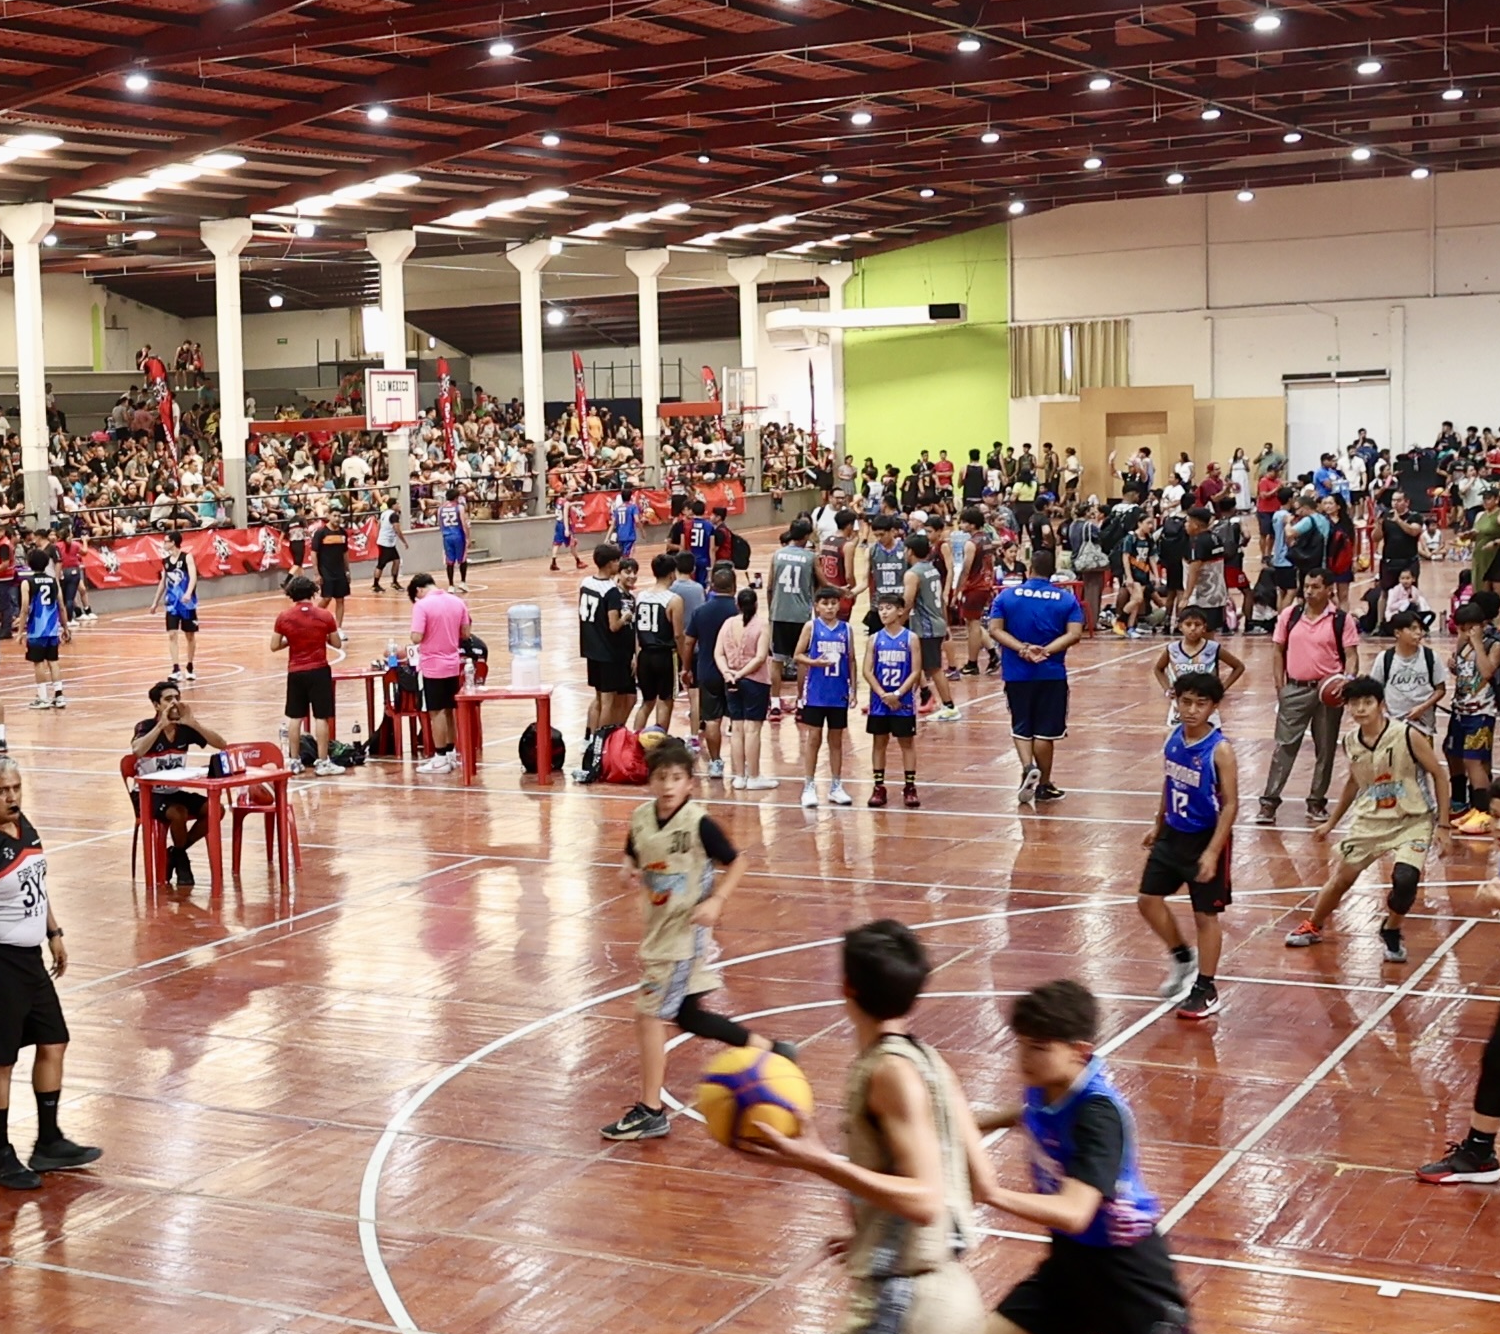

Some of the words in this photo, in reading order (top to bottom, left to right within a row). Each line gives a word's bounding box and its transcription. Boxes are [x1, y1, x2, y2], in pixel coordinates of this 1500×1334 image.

[778, 564, 802, 594] 41
[39, 584, 51, 605] 2
[1014, 588, 1061, 600] COACH
[882, 668, 901, 686] 22
